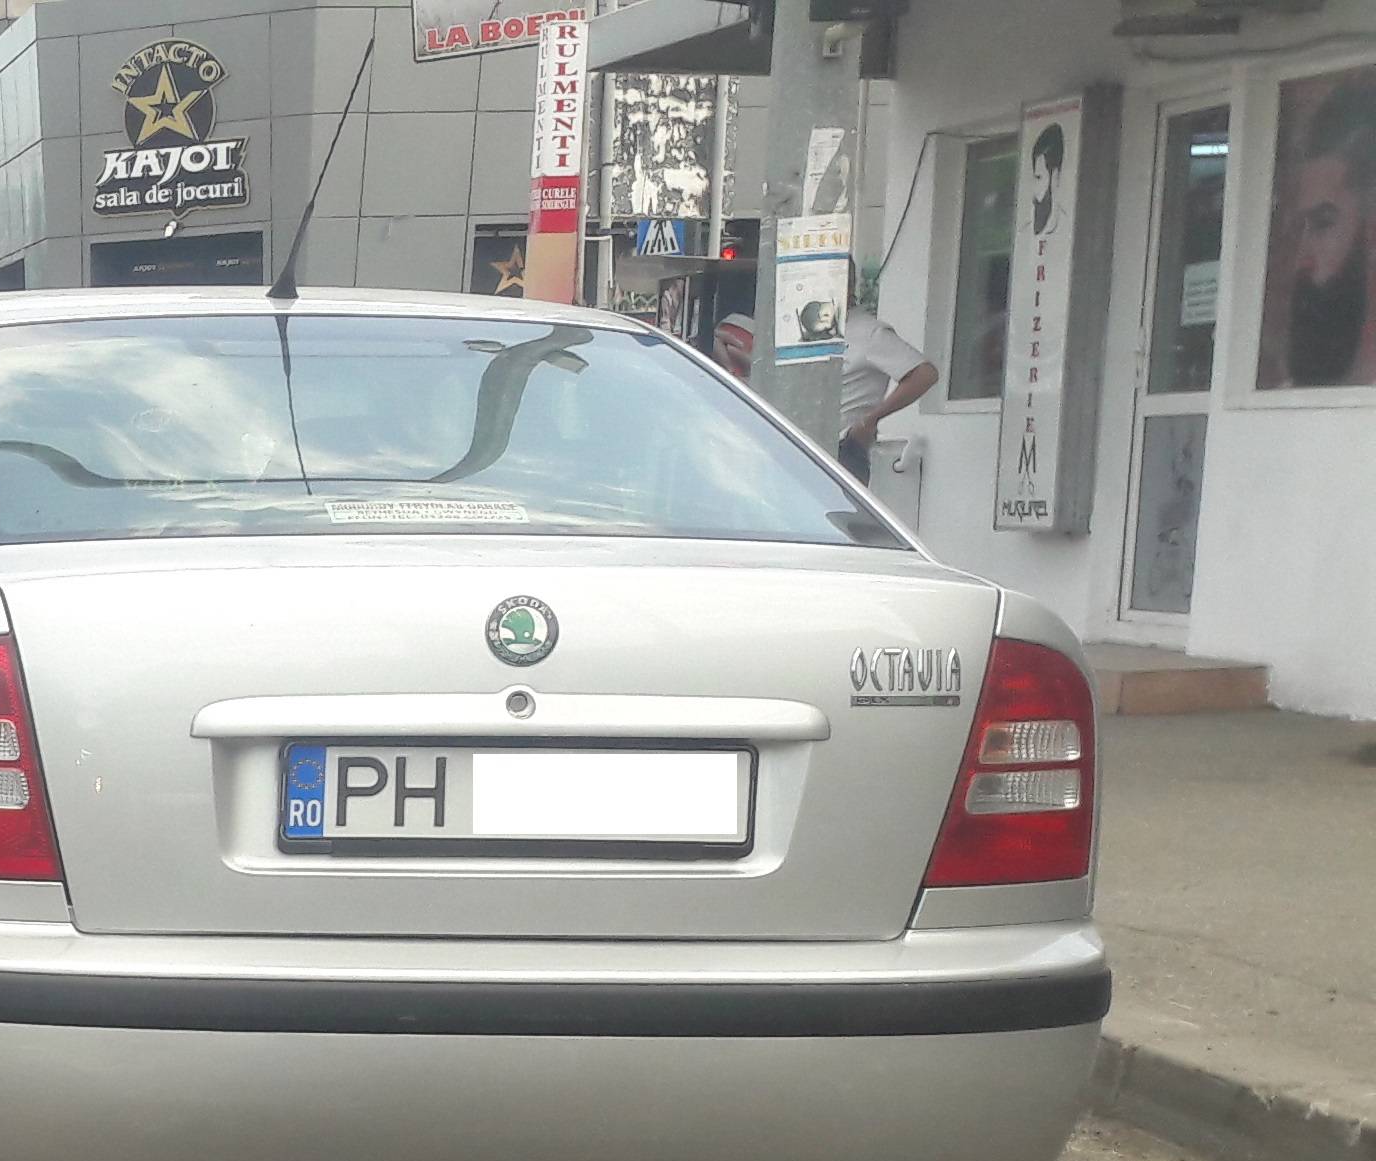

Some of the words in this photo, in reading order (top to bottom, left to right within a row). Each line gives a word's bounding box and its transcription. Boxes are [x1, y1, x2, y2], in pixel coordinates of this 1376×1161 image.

[427, 26, 470, 49] LA
[112, 42, 221, 92] INTACTO
[552, 25, 579, 168] RULMENTI
[95, 141, 238, 187] KAJOT
[96, 187, 140, 209] sala
[145, 182, 171, 204] de
[176, 178, 244, 207] jocuri
[542, 187, 576, 199] CURELE
[1025, 240, 1047, 433] FRIZERIE
[849, 647, 961, 692] OCTAVIA
[289, 799, 322, 827] RO
[336, 756, 447, 828] PH
